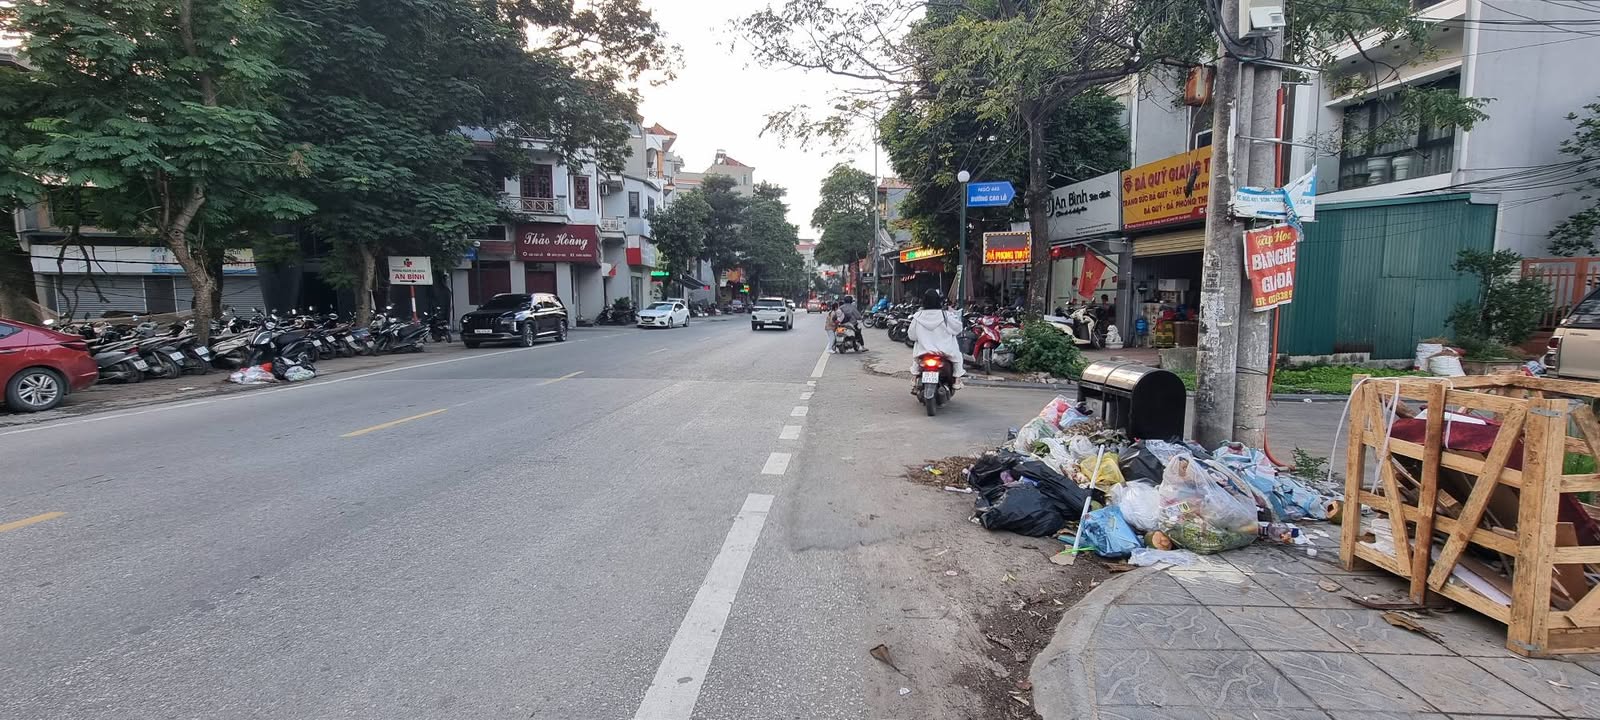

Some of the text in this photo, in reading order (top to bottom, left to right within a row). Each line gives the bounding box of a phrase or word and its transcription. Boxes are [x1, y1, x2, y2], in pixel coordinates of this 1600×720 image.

[1134, 172, 1147, 191] ĐÁ
[1148, 166, 1167, 188] QUÝ
[1055, 196, 1067, 210] An
[1122, 198, 1138, 207] TRANG
[523, 231, 589, 251] Thảo Hoàng
